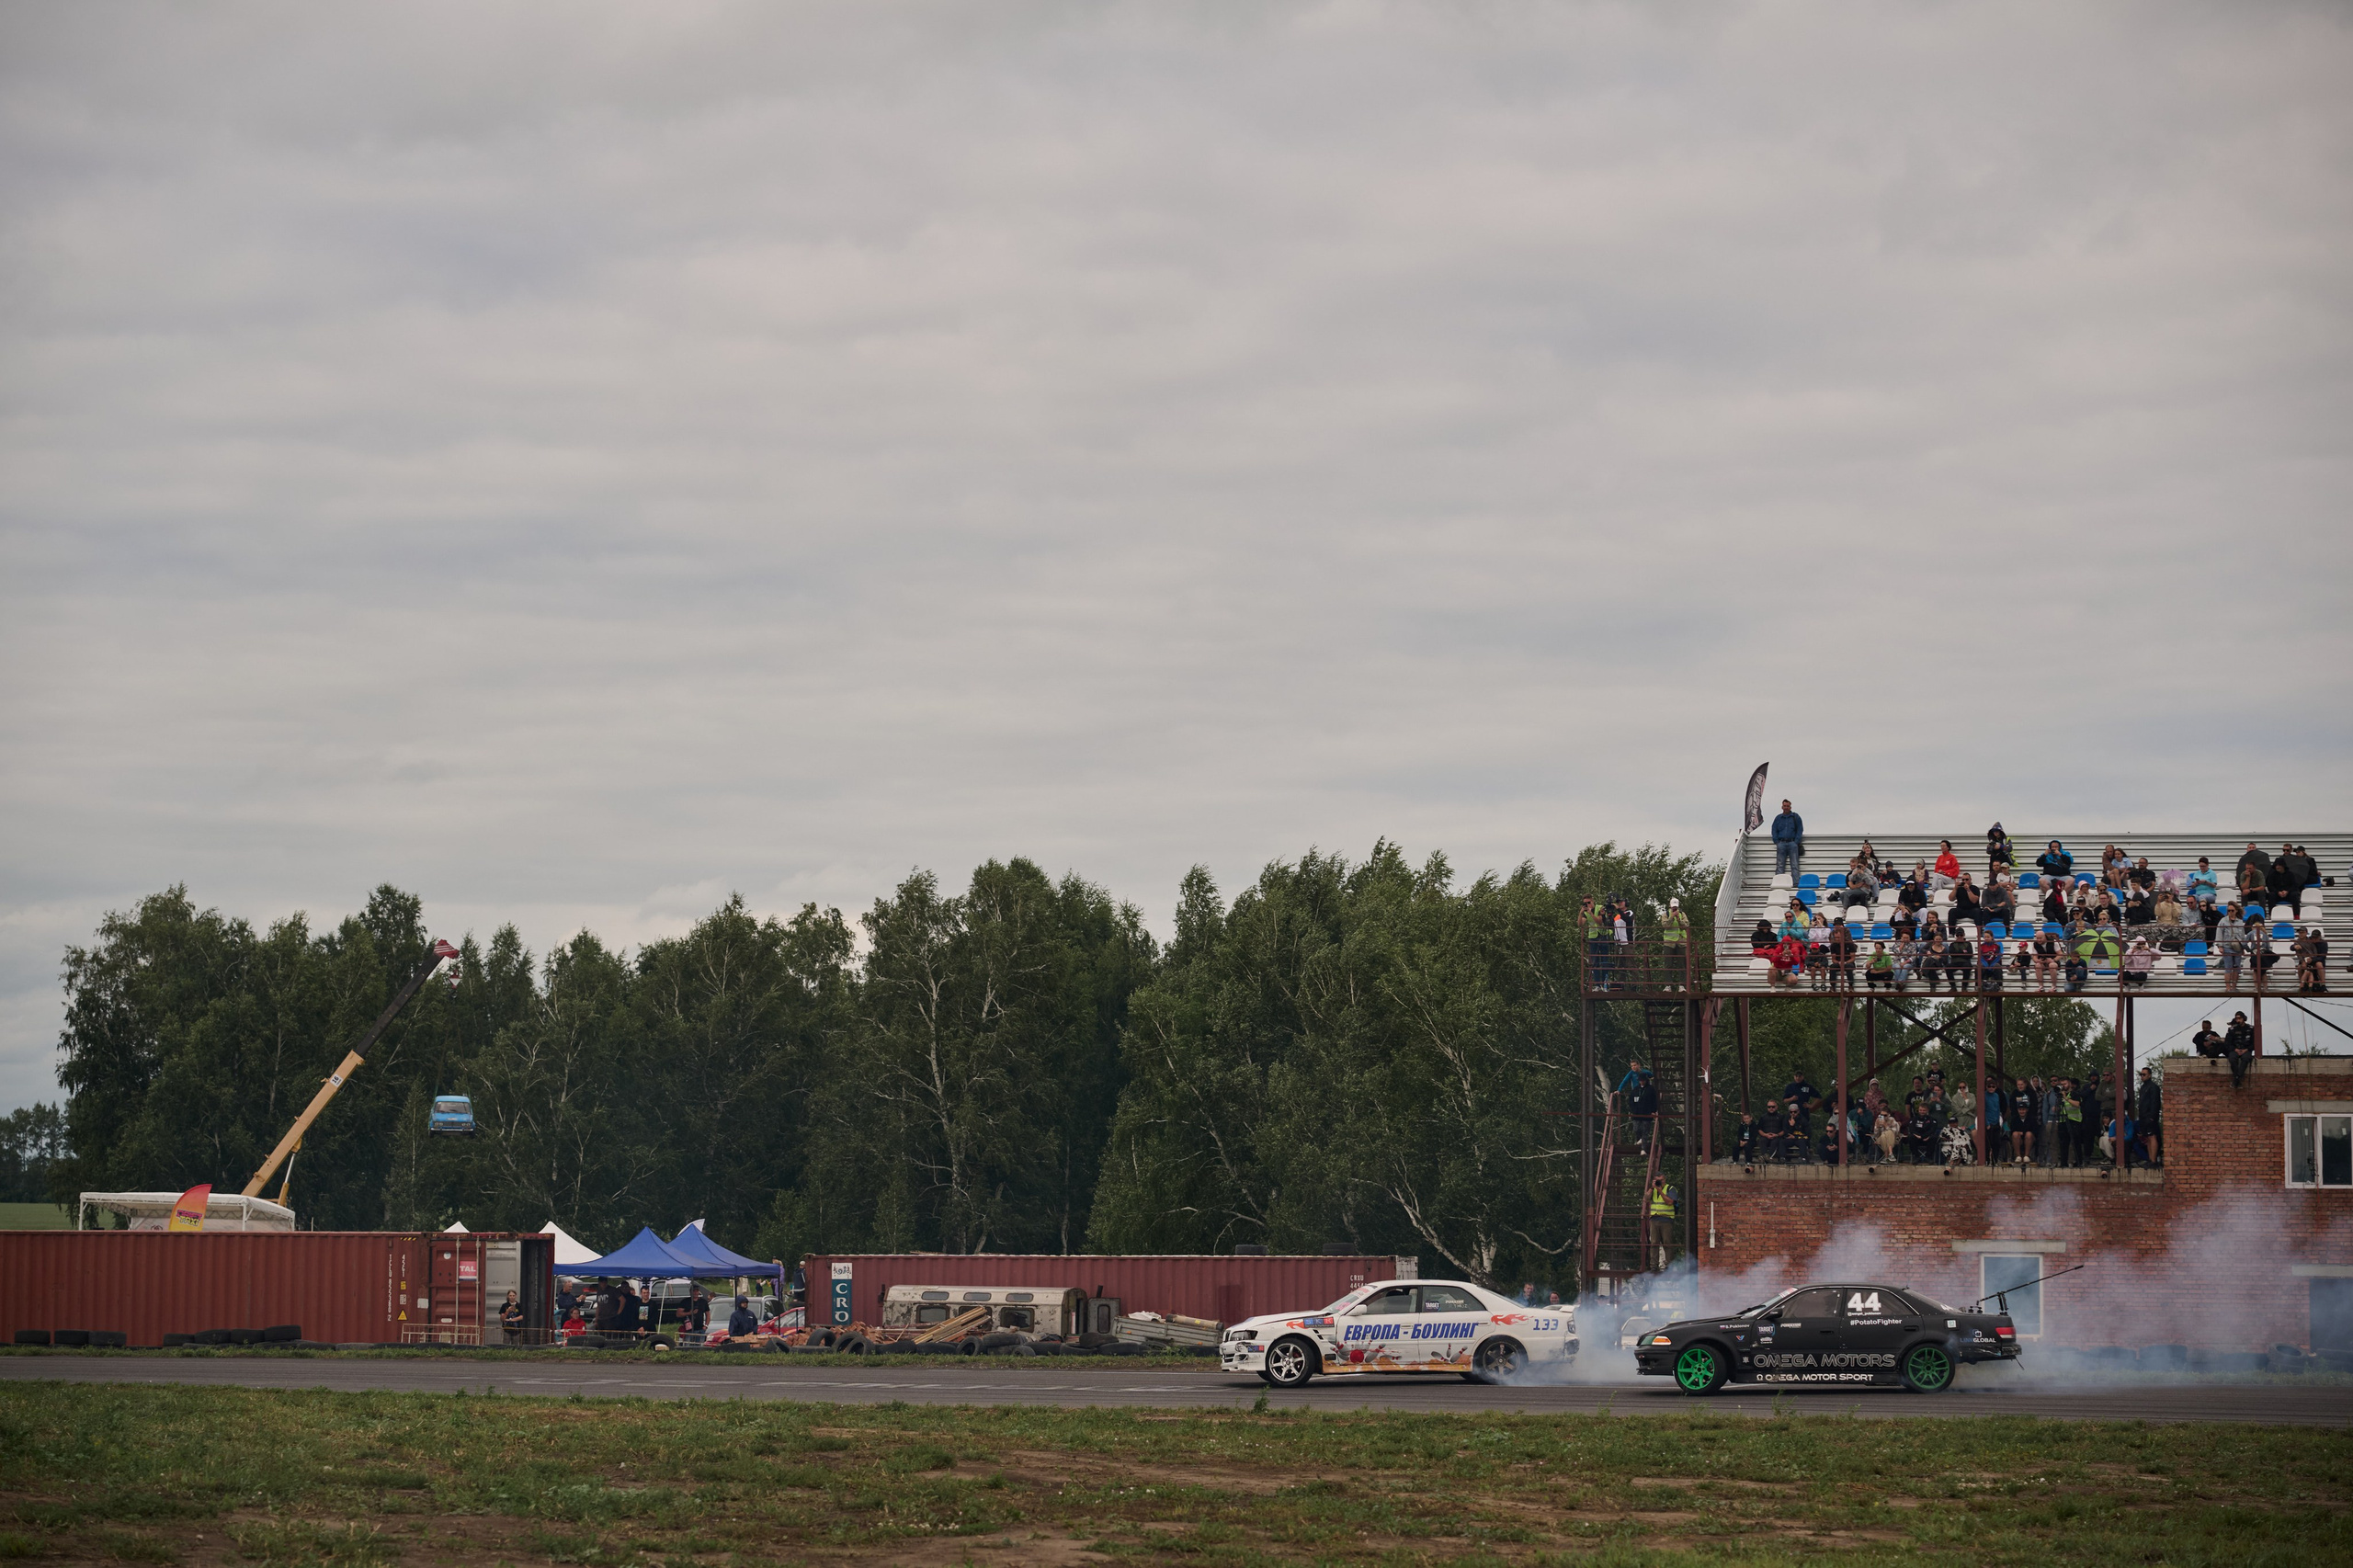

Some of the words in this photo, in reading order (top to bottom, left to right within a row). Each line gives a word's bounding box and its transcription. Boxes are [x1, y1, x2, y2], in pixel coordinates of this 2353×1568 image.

[1847, 1292, 1881, 1312] 44
[1344, 1324, 1401, 1341] ЕВРОПА
[1411, 1322, 1479, 1339] БОУЛИНГ
[1533, 1319, 1559, 1331] 133
[1754, 1354, 1818, 1368] OMEGA
[1821, 1353, 1896, 1368] MOTORS
[1839, 1373, 1873, 1381] SPORT
